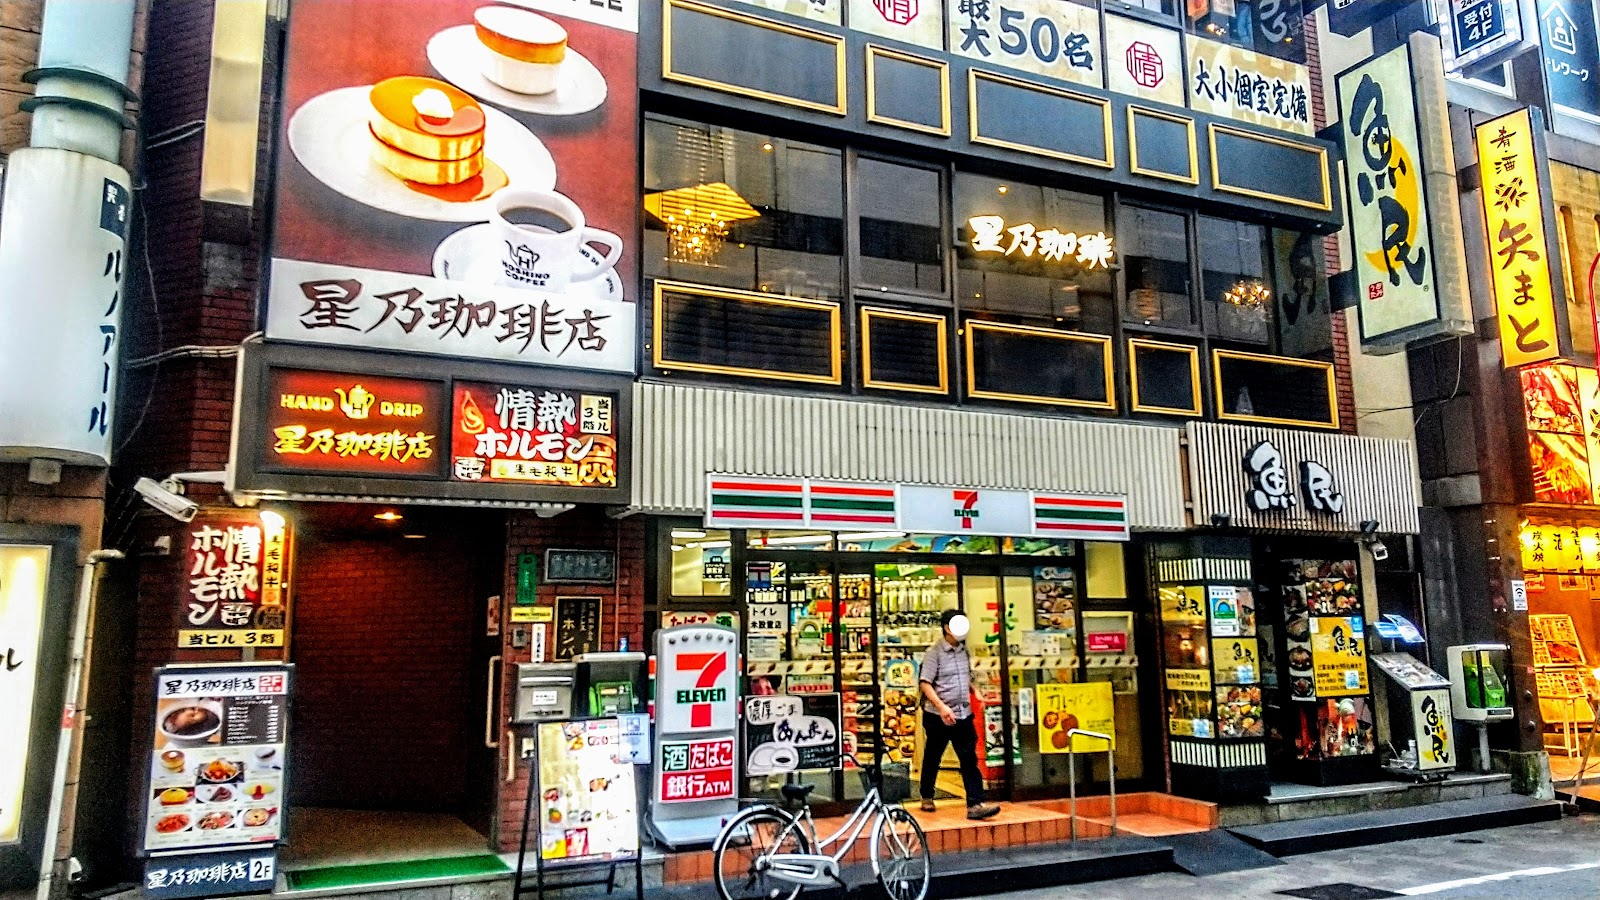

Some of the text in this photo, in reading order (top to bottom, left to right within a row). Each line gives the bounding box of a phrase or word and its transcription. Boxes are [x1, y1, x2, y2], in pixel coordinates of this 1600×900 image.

[1464, 2, 1493, 29] 受付
[1468, 20, 1493, 42] 4F
[1546, 57, 1590, 82] レワーク
[1194, 59, 1308, 124] 大小個室完備
[968, 214, 1115, 270] 星乃珈琲
[502, 260, 551, 280] HOSHINO
[504, 269, 547, 287] COFFEE
[1497, 218, 1551, 354] 矢まと
[299, 279, 612, 355] 星乃珈琲店
[88, 249, 122, 437] ルノアール
[280, 394, 424, 418] HAND DRIP
[494, 388, 577, 433] 情熱
[273, 425, 436, 463] 星乃珈琲店
[474, 427, 595, 462] ホルモン
[187, 525, 223, 626] ホルモン
[219, 525, 261, 600] 情熱
[752, 607, 778, 617] トイレ
[165, 677, 257, 695] 星乃珈琲店
[260, 675, 283, 687] 2F
[676, 651, 727, 728] 7
[664, 743, 733, 771] 酒 たばこ
[147, 860, 271, 889] 星乃珈琲店 2F
